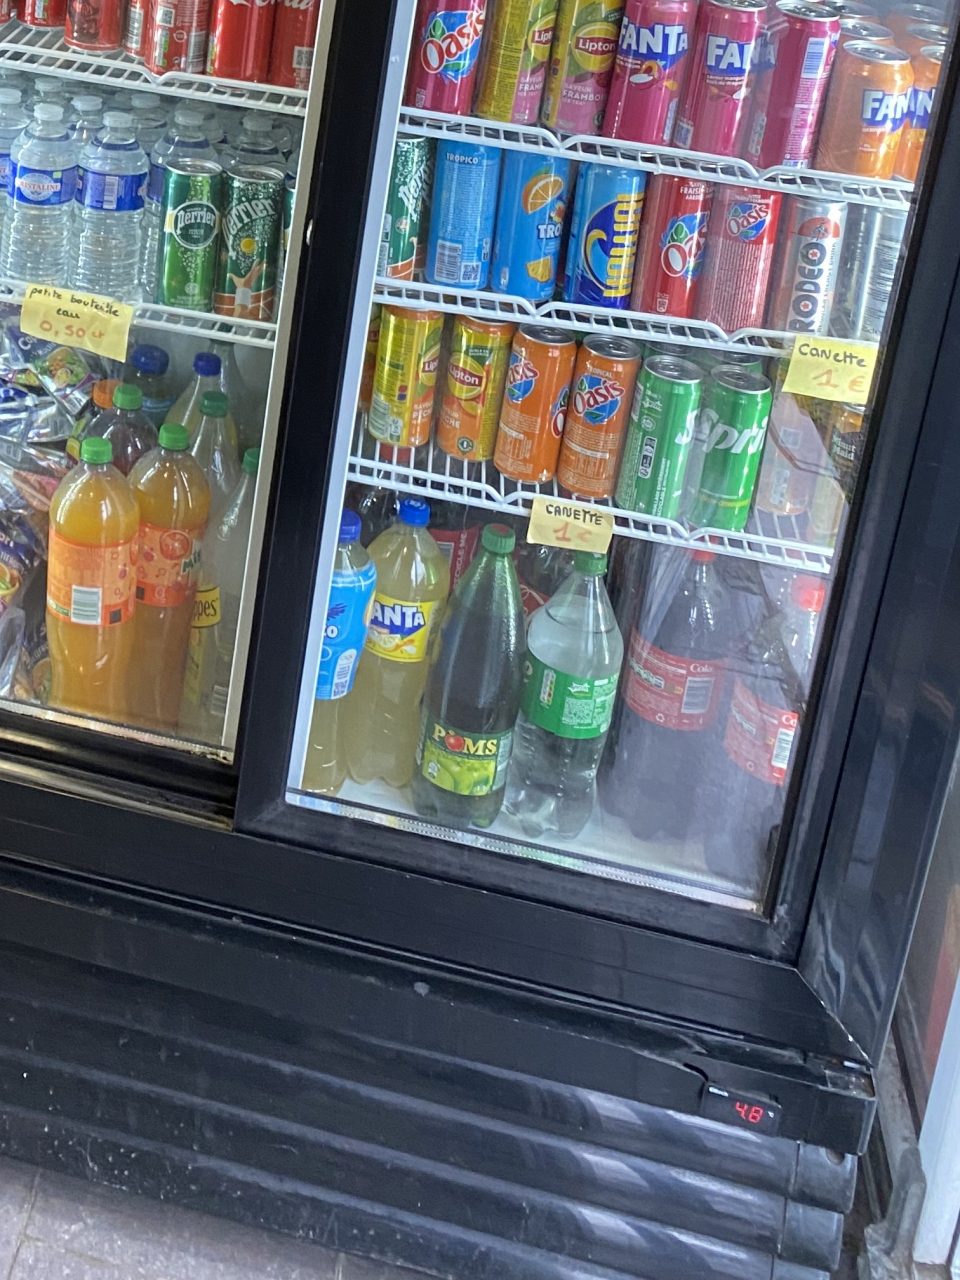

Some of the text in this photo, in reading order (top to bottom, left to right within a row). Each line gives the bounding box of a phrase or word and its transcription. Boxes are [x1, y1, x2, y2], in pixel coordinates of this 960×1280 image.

[533, 28, 553, 43] Lipt
[578, 38, 617, 52] Lipton
[618, 16, 689, 56] FANTA
[562, 90, 602, 102] FRAMBO
[862, 90, 914, 121] FAN
[446, 152, 480, 165] TROPICO
[726, 203, 770, 237] Oasis
[788, 242, 827, 333] RODEO
[55, 307, 81, 320] eau
[424, 360, 439, 372] Lip
[572, 378, 626, 417] Oasis
[700, 407, 769, 454] Spri
[545, 503, 604, 526] CANETTE
[371, 600, 426, 628] ANTA
[431, 722, 499, 758] POMS
